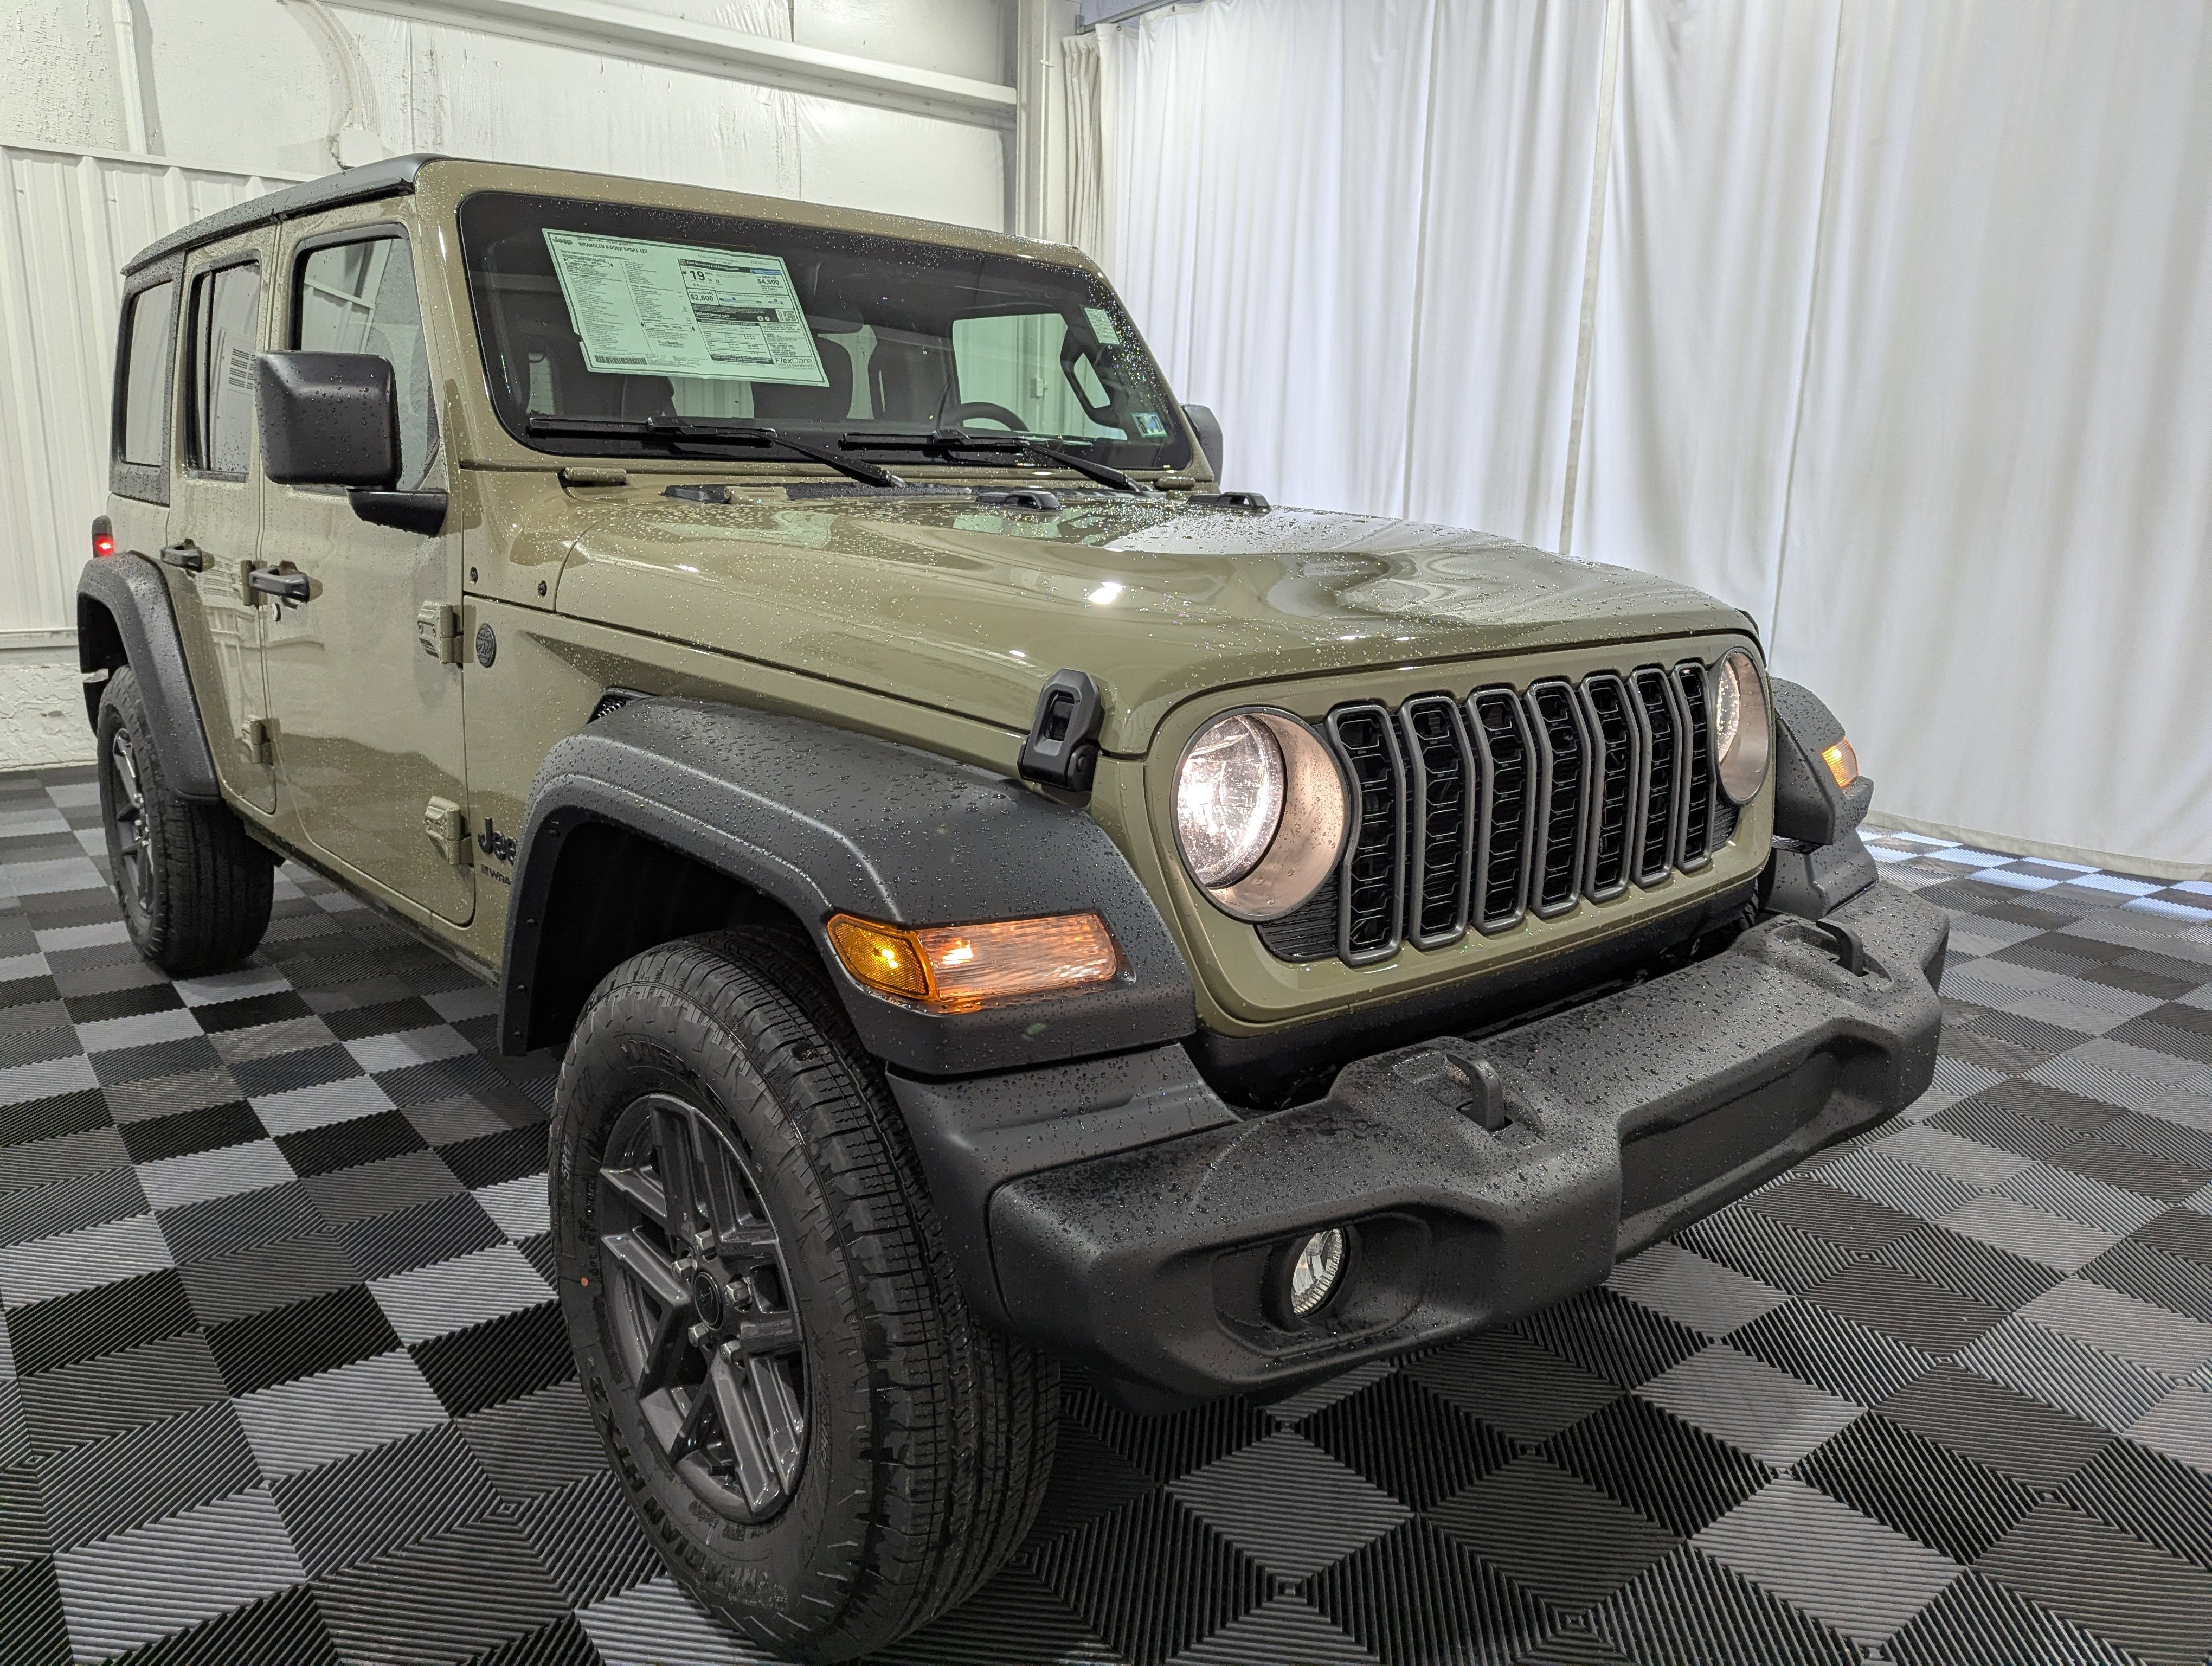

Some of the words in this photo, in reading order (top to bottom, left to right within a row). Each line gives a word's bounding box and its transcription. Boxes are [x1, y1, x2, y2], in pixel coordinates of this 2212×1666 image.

[552, 236, 573, 245] Jeep
[690, 270, 705, 281] 19
[477, 816, 518, 866] Jee
[488, 867, 512, 886] WRA
